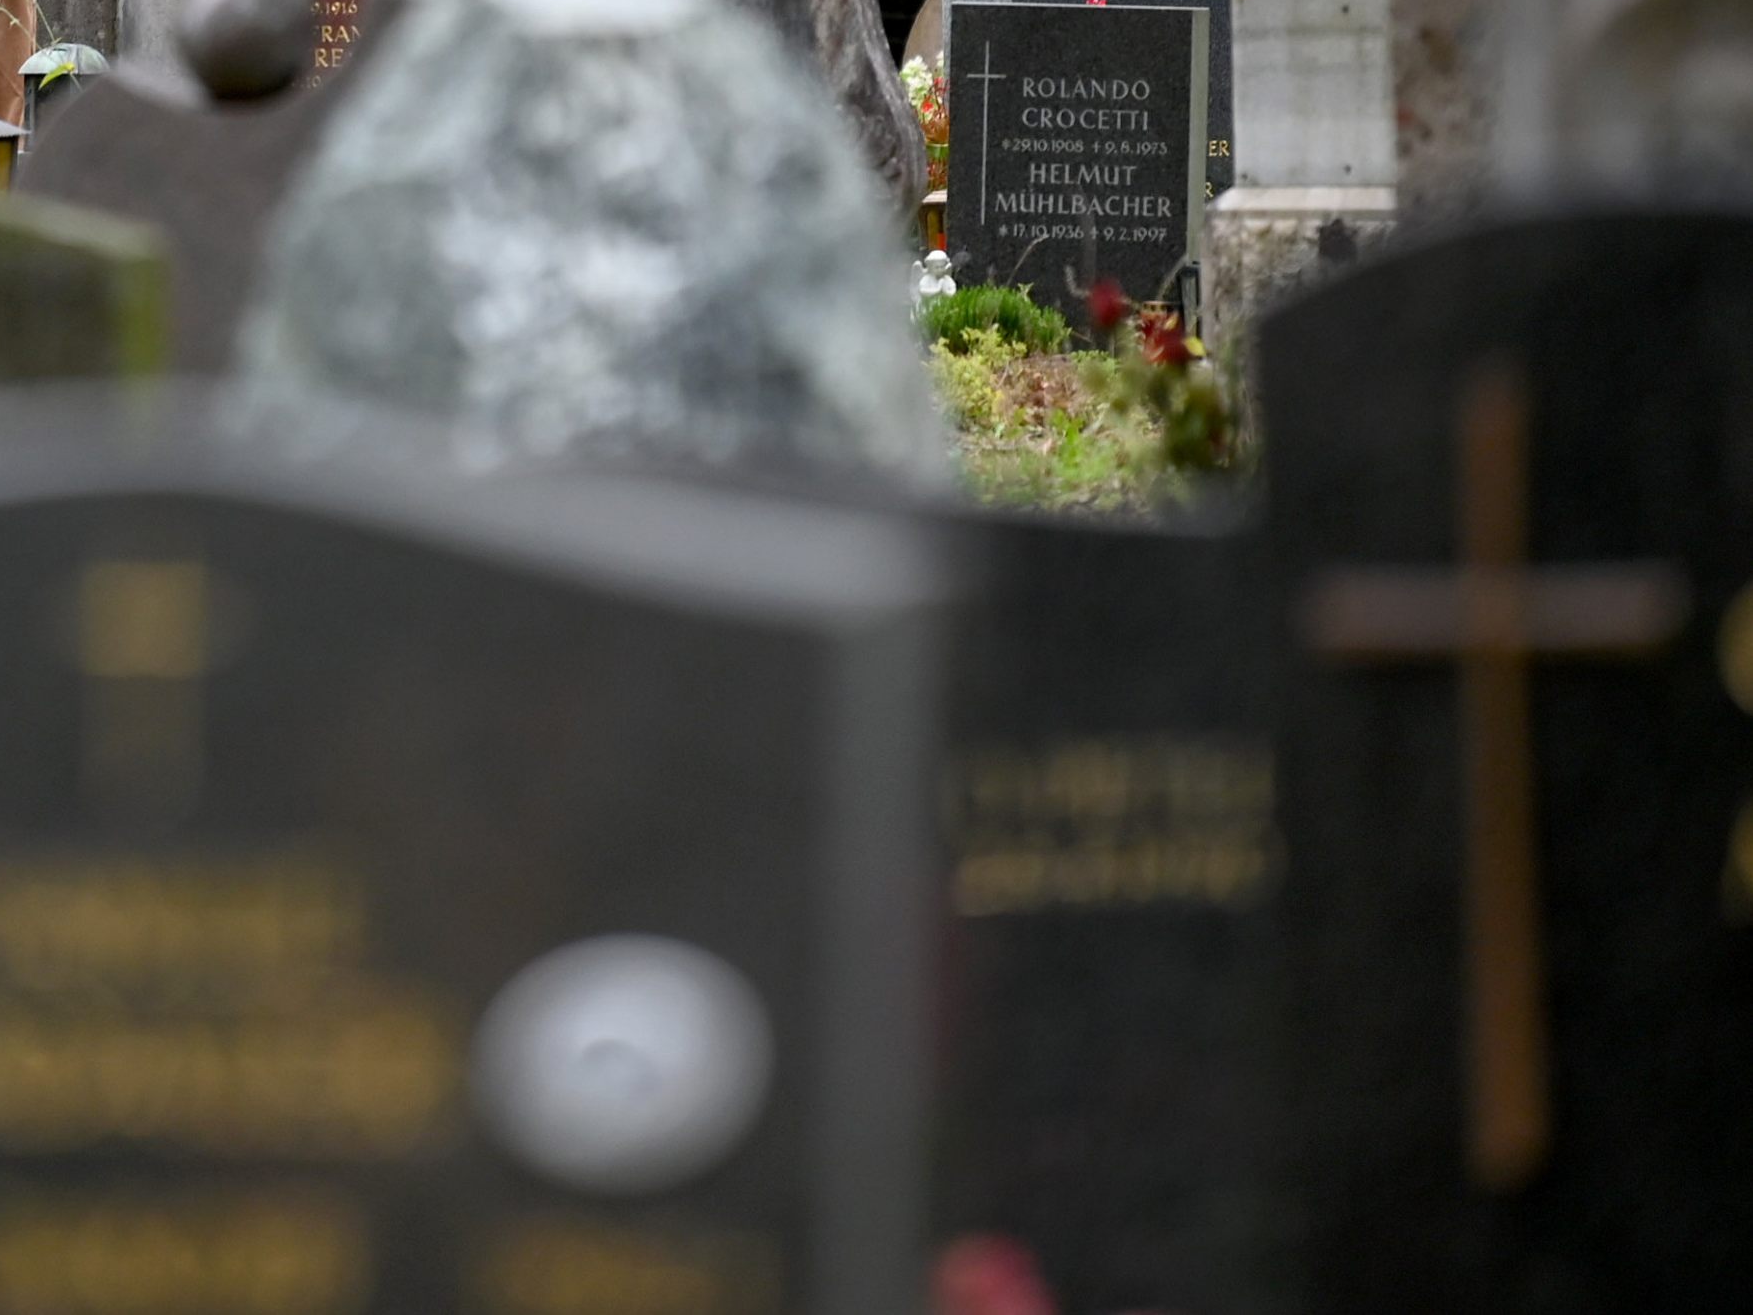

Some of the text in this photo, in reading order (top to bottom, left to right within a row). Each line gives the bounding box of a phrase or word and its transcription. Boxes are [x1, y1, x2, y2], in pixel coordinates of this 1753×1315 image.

[1022, 77, 1150, 101] ROLANDO
[1022, 108, 1148, 131] CROCETTI
[1030, 163, 1137, 185] HELMUT
[994, 187, 1172, 218] MÜHLBACHER
